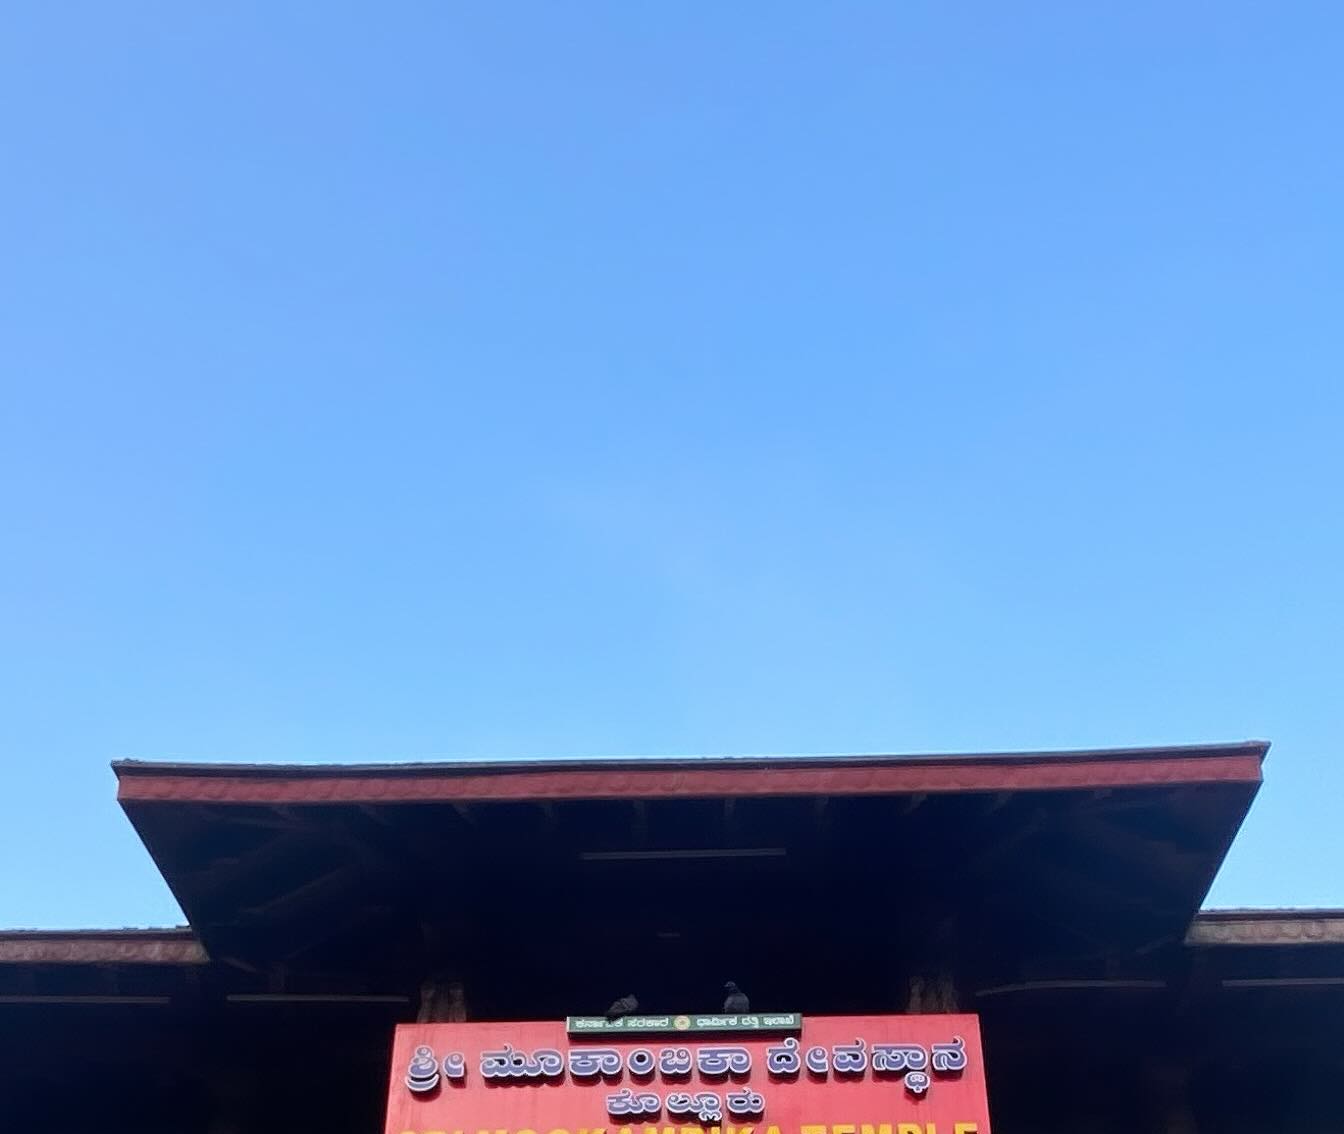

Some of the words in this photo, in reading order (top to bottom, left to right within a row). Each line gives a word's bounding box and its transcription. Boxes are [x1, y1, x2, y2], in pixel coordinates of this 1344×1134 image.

[405, 1045, 465, 1091] ಶ್ರೀ
[480, 1044, 752, 1077] ಮೂಕಾಂಬಿಕಾ
[767, 1036, 967, 1093] ದೇವಸ್ಥಾನ
[607, 1087, 765, 1121] ಕೊಲ್ಲೂರು
